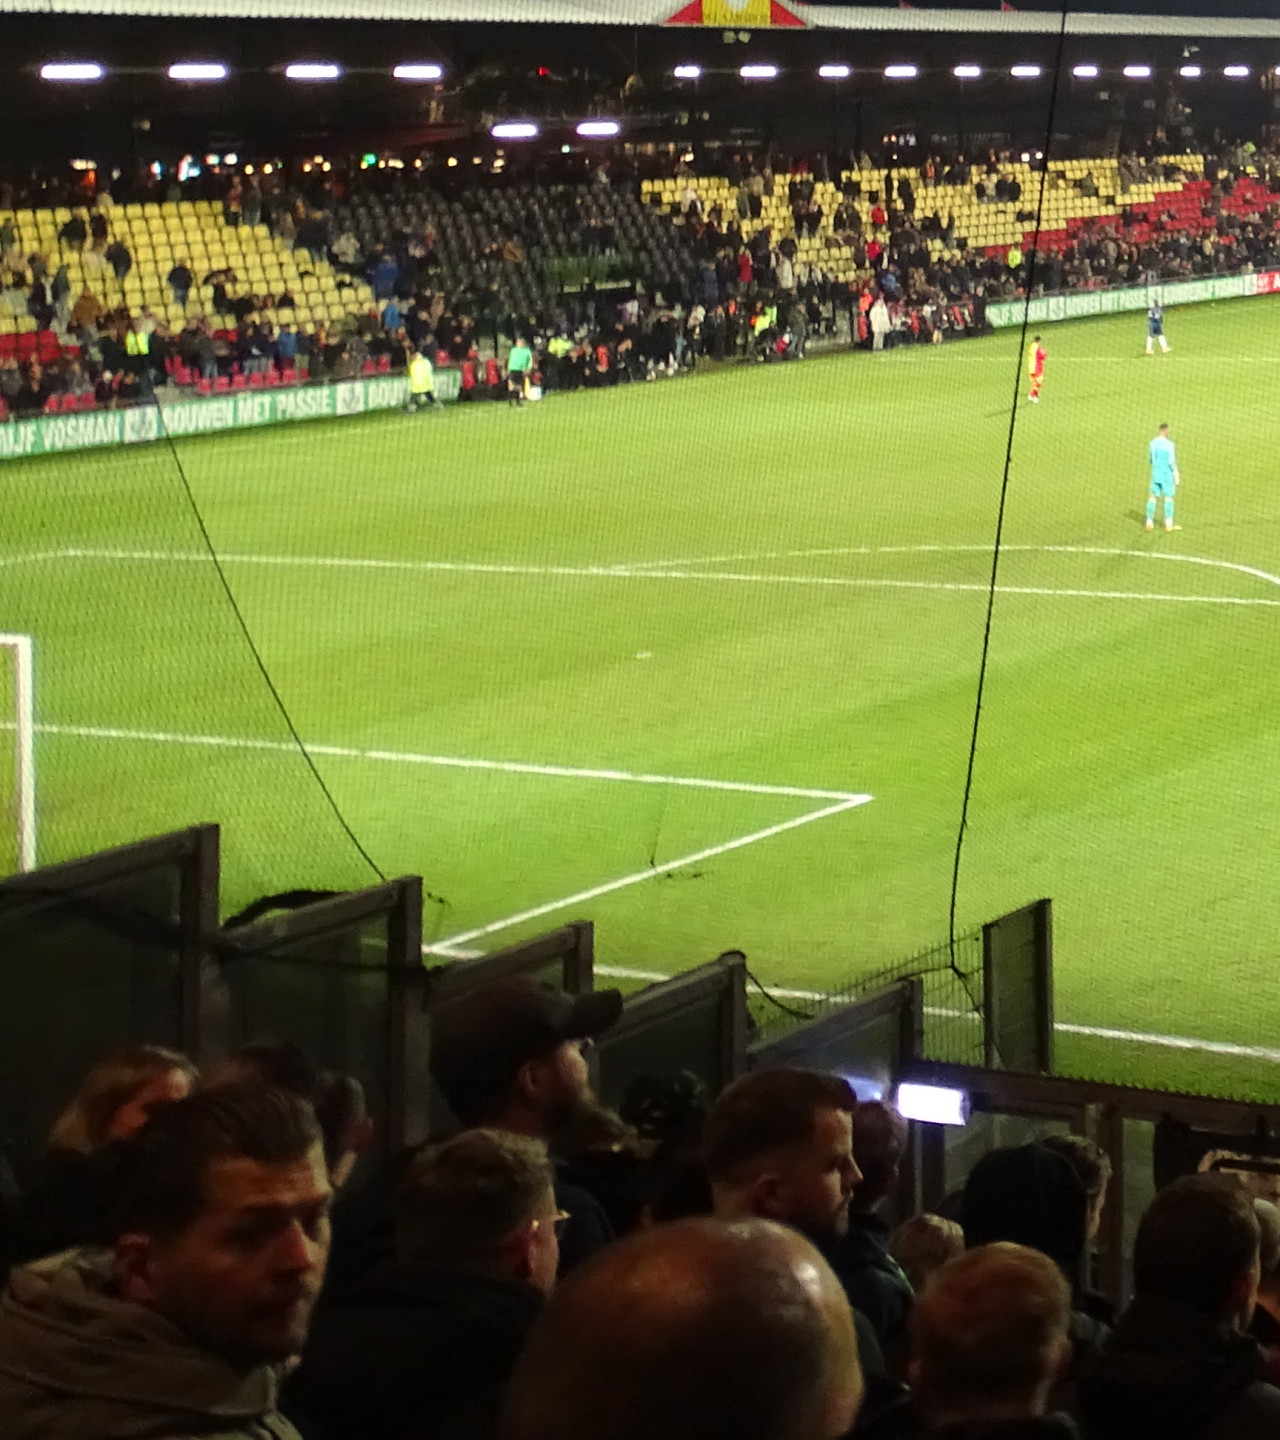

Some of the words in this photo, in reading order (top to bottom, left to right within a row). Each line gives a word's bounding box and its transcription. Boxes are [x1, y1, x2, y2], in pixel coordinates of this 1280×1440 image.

[237, 393, 272, 427] MET
[275, 385, 331, 419] PASSIE
[41, 413, 121, 451] VOSMAN
